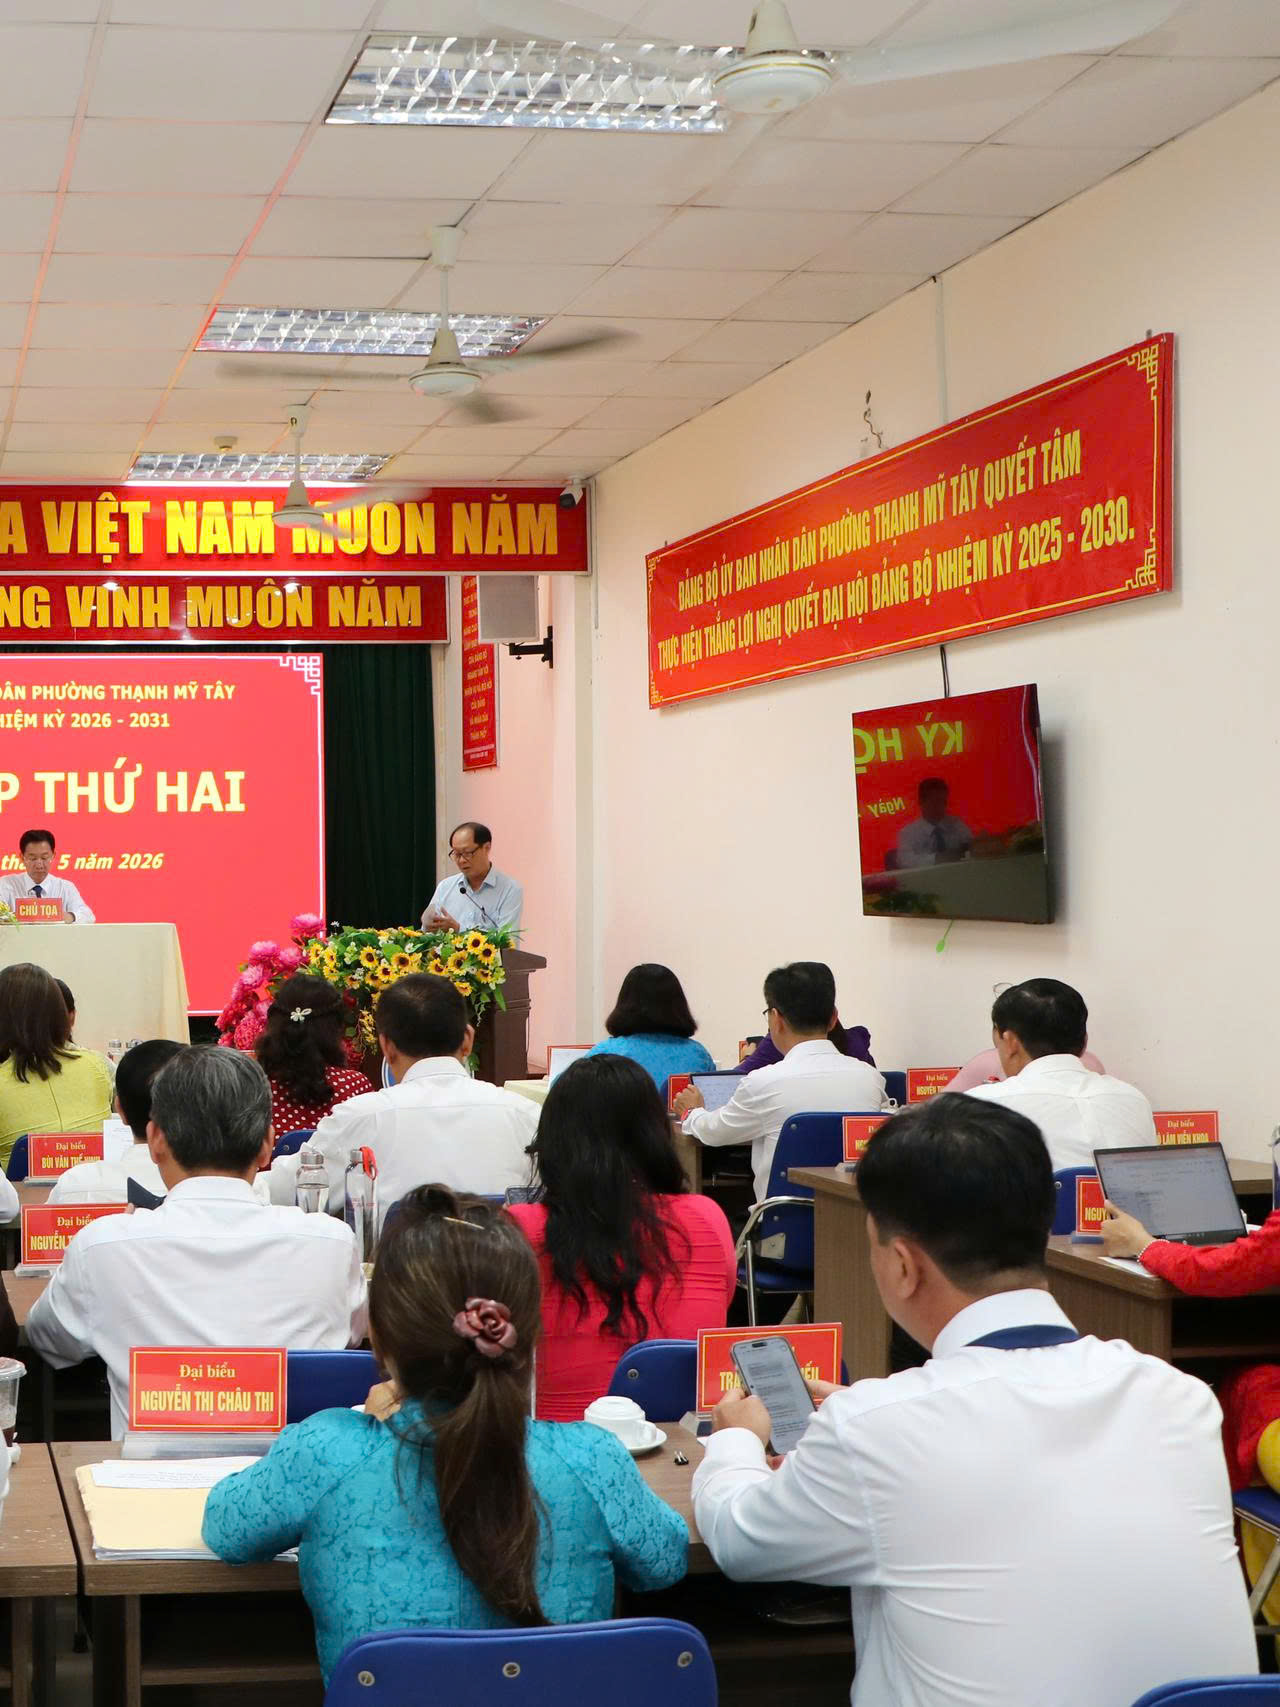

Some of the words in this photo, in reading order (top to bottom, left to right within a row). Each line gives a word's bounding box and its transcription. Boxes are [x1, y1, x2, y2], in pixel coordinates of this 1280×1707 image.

[45, 492, 149, 563] VIỆT
[166, 500, 275, 554] NAM
[452, 494, 558, 555] NĂM
[678, 568, 703, 611] ĐẢNG
[706, 561, 718, 606] BỘ
[721, 554, 734, 597] ỦY
[736, 553, 757, 591] BAN
[760, 537, 790, 583] NHÂN
[793, 526, 817, 571] DÂN
[820, 508, 870, 562] PHƯỜNG
[874, 491, 919, 546] THẠNH
[923, 473, 947, 527] MỸ
[950, 464, 979, 516] TÂY
[983, 435, 1036, 508] QUYẾT
[1041, 427, 1081, 485] TÂM
[658, 634, 679, 675] THỰC
[681, 625, 703, 669] HIỆN
[704, 611, 735, 657] THẮNG
[738, 610, 754, 654] LỢI
[756, 604, 782, 645] NGHỊ
[784, 581, 820, 638] QUYẾT
[823, 584, 843, 630] ĐẠI
[847, 571, 868, 623] HỘI
[872, 558, 909, 611] ĐẢNG
[913, 549, 932, 605] BỘ
[936, 536, 987, 594] NHIỆM
[992, 522, 1013, 577] KỲ
[1018, 516, 1062, 570] 2025
[1080, 496, 1135, 553] 2030.
[67, 586, 169, 629] VINH
[187, 578, 313, 628] MUÔN
[328, 578, 422, 628] NĂM
[32, 682, 105, 700] PHƯỜNG
[111, 685, 168, 703] THẠNH
[174, 681, 198, 699] MỸ
[203, 681, 235, 699] TÂY
[43, 709, 65, 728] KỲ
[71, 713, 112, 728] 2026
[130, 713, 170, 728] 2031
[34, 757, 143, 813] THỨ
[156, 771, 246, 813] HAI
[57, 854, 71, 870] 5
[74, 854, 113, 870] năm
[118, 853, 164, 869] 2026
[19, 901, 38, 916] CHỦ
[40, 904, 58, 919] TỌA
[55, 1142, 69, 1151] Đại
[70, 1140, 86, 1150] biểu
[55, 1154, 69, 1168] VĂN
[57, 1216, 73, 1228] Đại
[76, 1214, 96, 1226] biể
[1084, 1207, 1107, 1221] NGUY
[30, 1230, 66, 1250] NGUYỄN
[179, 1364, 203, 1381] Đại
[207, 1361, 236, 1378] biểu
[140, 1384, 191, 1412] NGUYỄN
[194, 1391, 214, 1416] THỊ
[217, 1387, 251, 1412] CHÂU
[254, 1391, 274, 1412] THI
